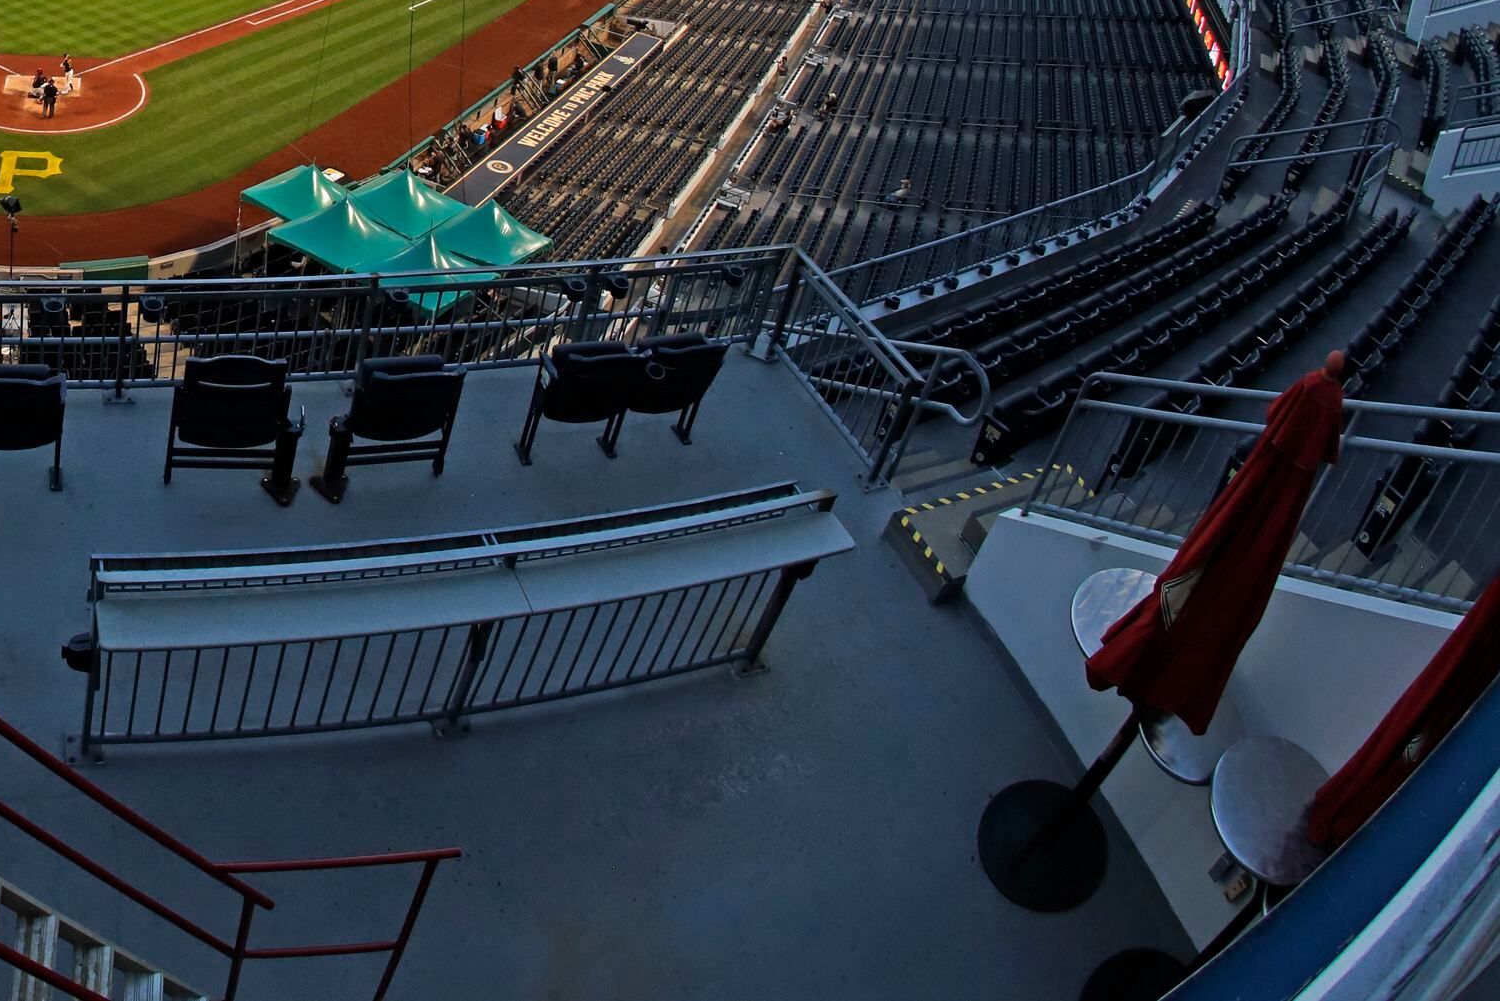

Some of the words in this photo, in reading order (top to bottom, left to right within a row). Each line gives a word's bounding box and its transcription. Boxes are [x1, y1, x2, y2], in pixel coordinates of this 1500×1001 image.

[517, 108, 571, 148] WELCOME
[565, 101, 578, 112] TO
[574, 87, 596, 105] PNC
[587, 71, 615, 94] PARK
